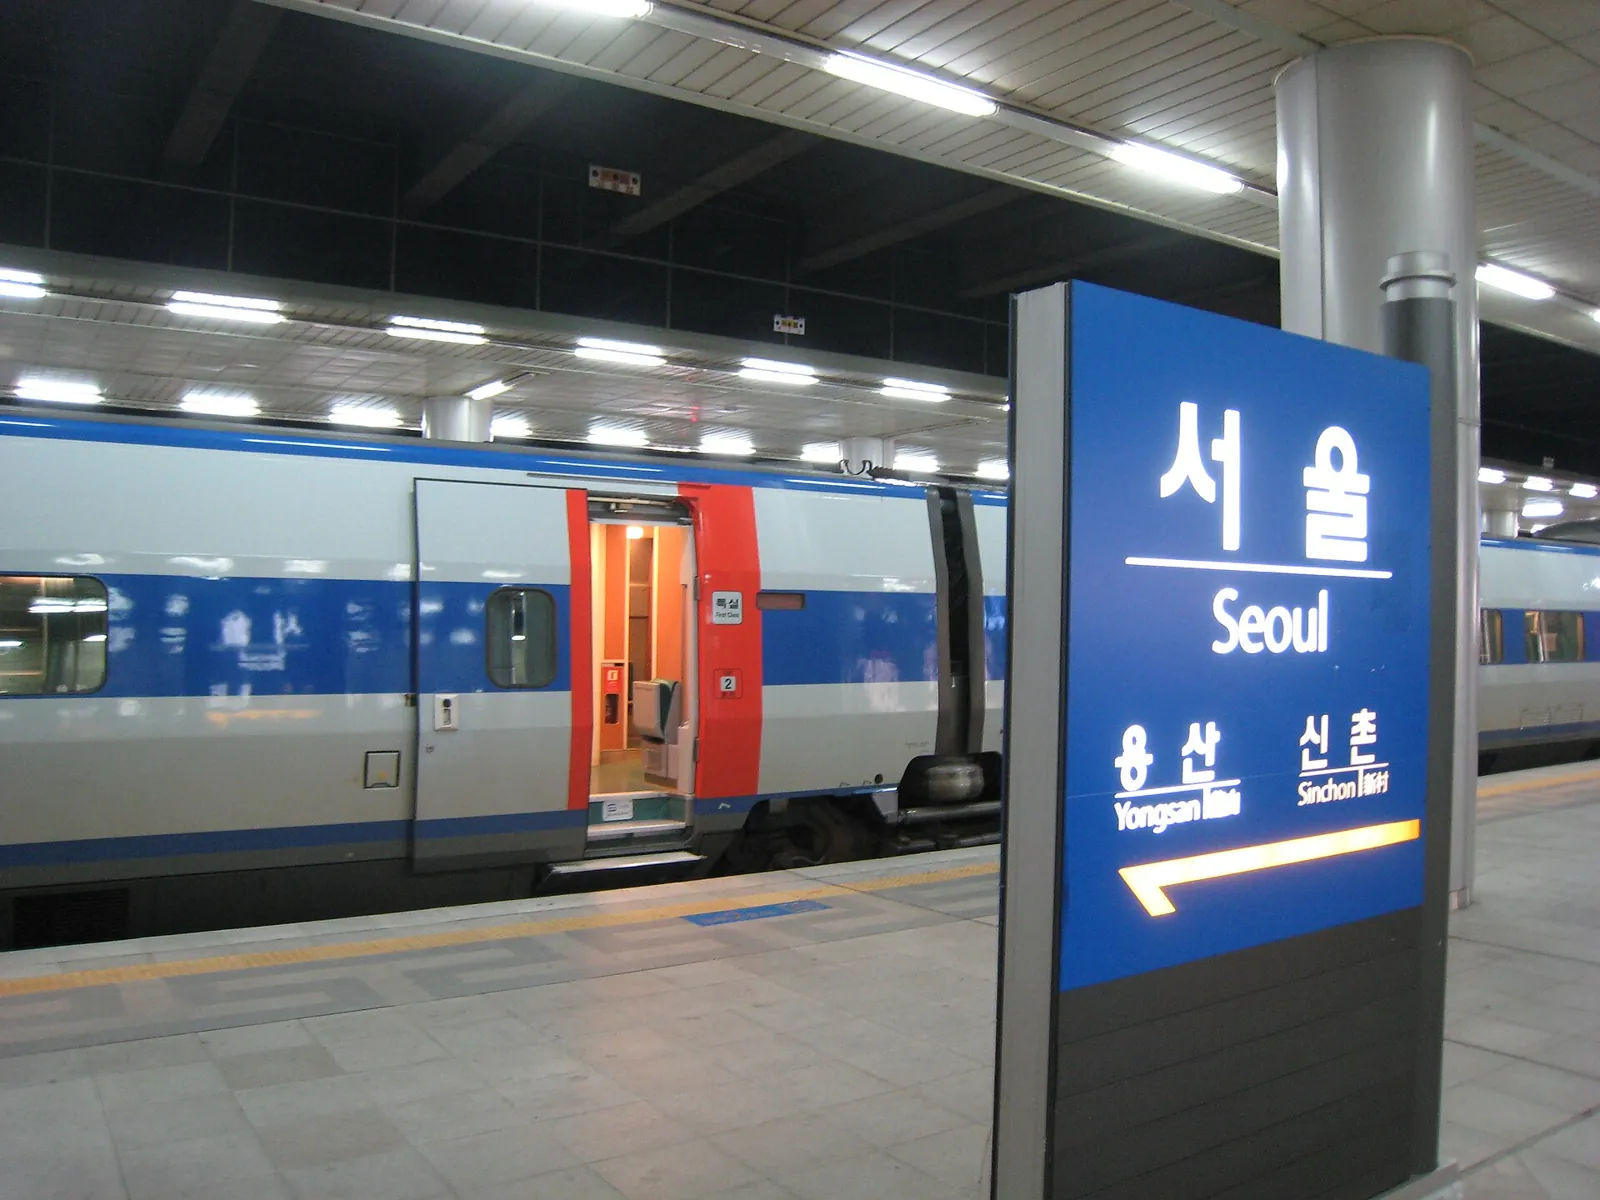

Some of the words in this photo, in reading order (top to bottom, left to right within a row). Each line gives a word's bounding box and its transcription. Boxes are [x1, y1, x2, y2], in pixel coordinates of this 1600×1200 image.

[1160, 401, 1371, 563] 서울
[1211, 587, 1329, 654] Seoul
[724, 678, 732, 690] 2
[1114, 721, 1221, 792] 용산
[1299, 708, 1377, 771] 신촌
[1113, 800, 1201, 834] Yongsan
[1297, 777, 1356, 806] Sinchon
